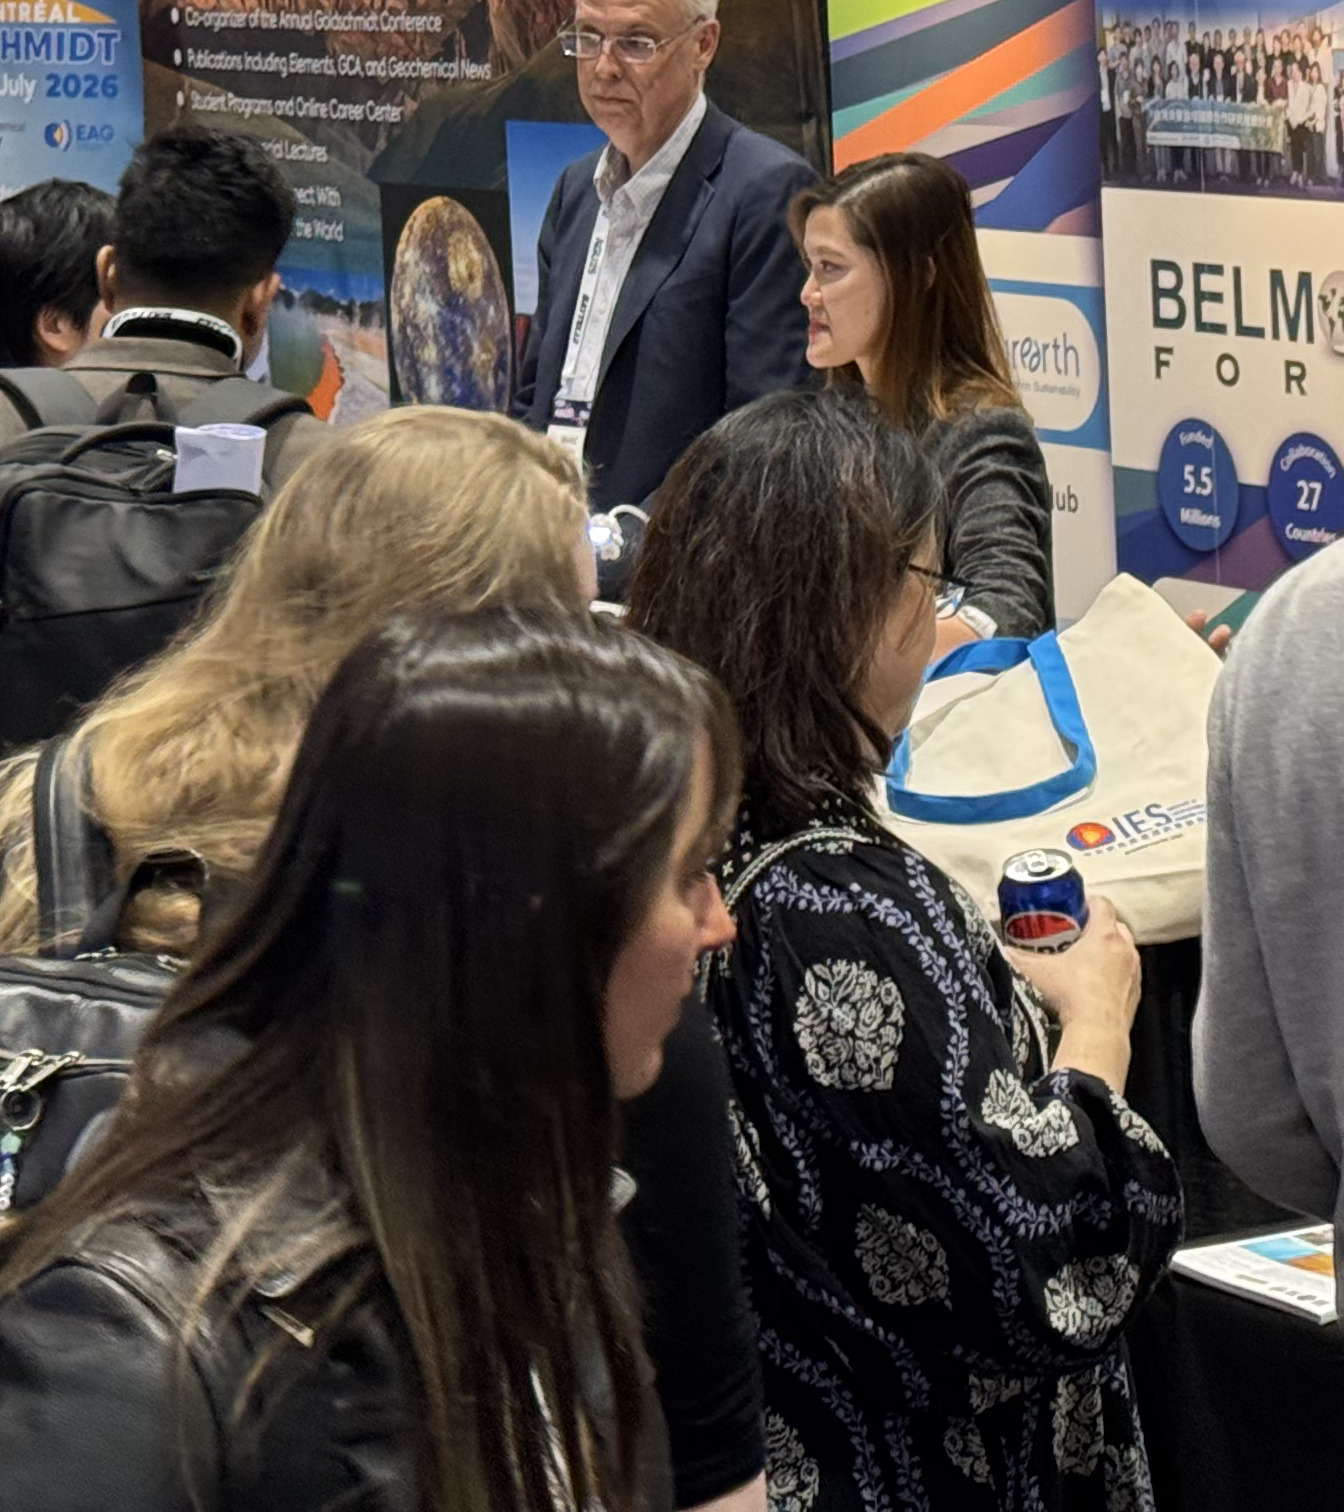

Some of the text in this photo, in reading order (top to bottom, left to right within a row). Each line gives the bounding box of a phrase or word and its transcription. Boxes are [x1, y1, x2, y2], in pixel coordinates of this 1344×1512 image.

[380, 10, 442, 33] Conference
[365, 56, 387, 77] and
[388, 55, 459, 79] Geochemical
[460, 59, 492, 80] News
[45, 73, 119, 100] 2026
[274, 95, 294, 117] and
[76, 123, 115, 143] EAG
[1183, 463, 1214, 496] 5.5
[1296, 479, 1323, 512] 27
[1112, 802, 1173, 841] IES
